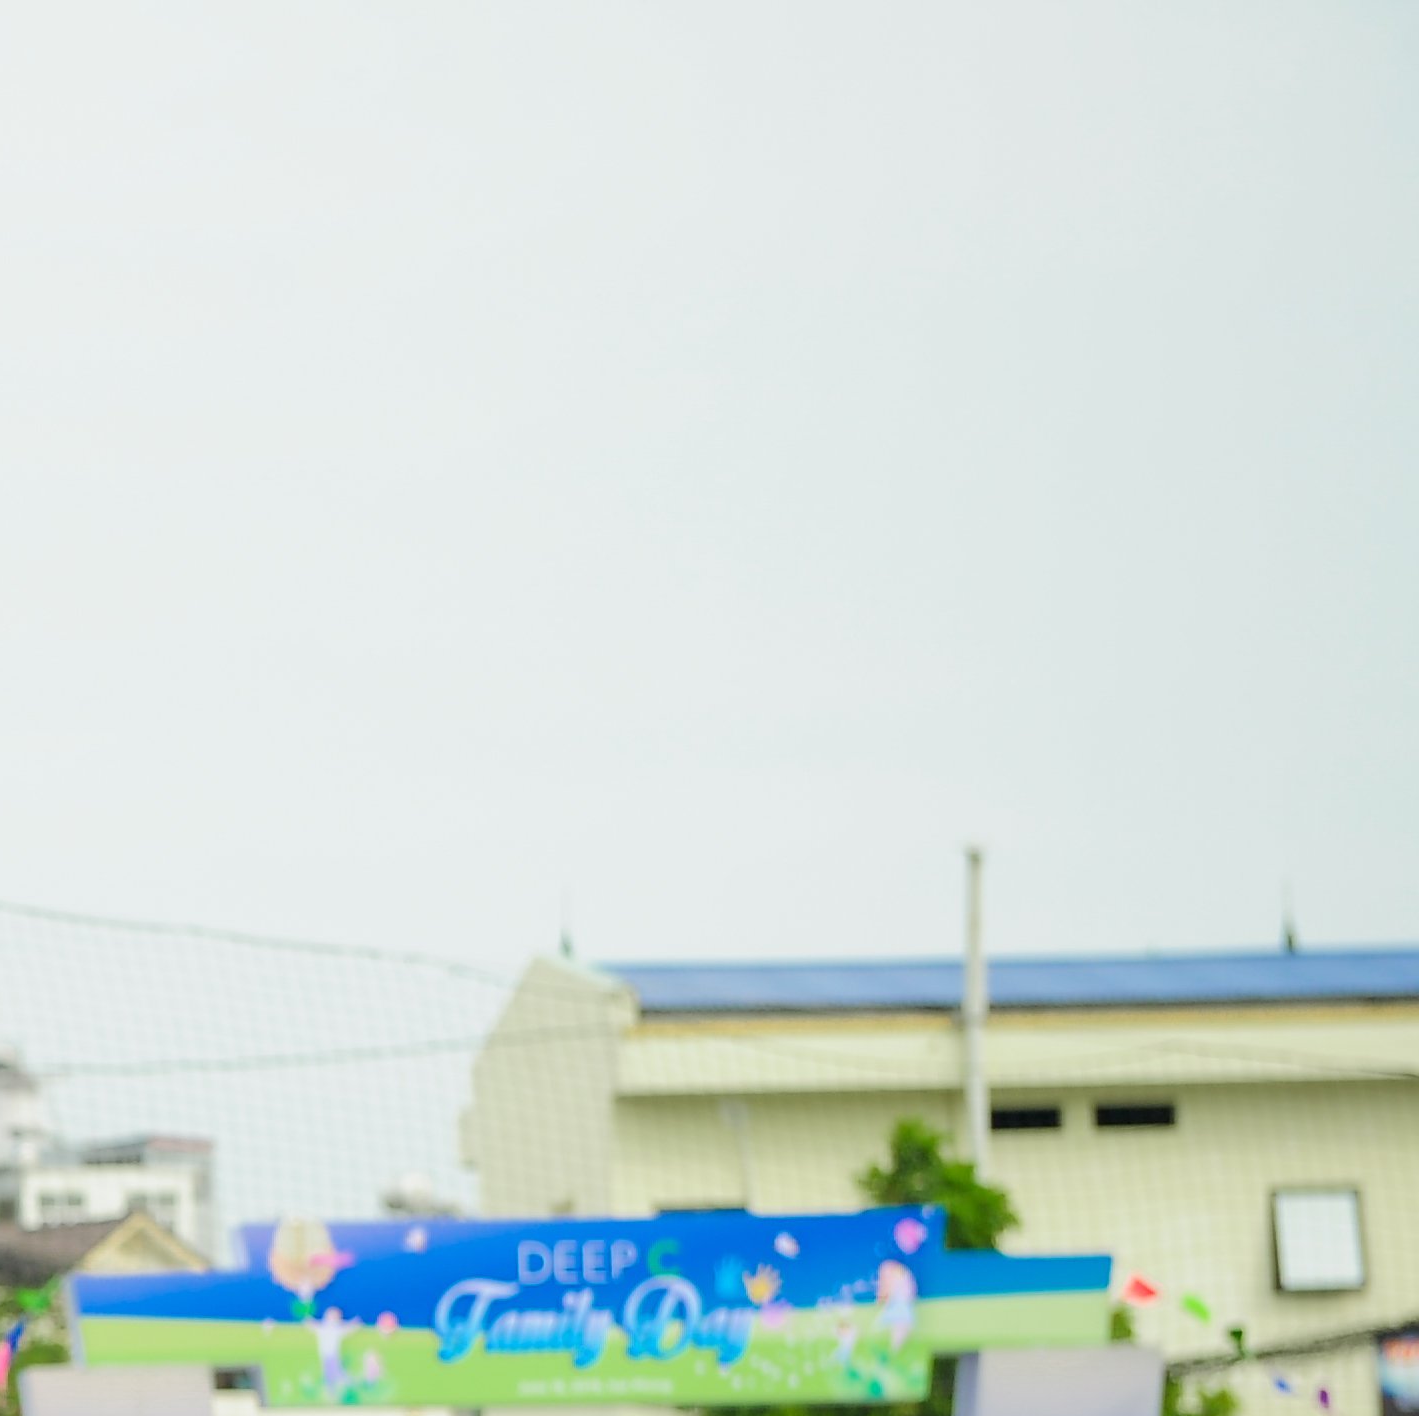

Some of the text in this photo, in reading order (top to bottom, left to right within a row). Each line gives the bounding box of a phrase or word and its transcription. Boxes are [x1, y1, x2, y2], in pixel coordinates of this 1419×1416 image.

[519, 1238, 682, 1283] DEEP C
[436, 1275, 756, 1367] Family Day
